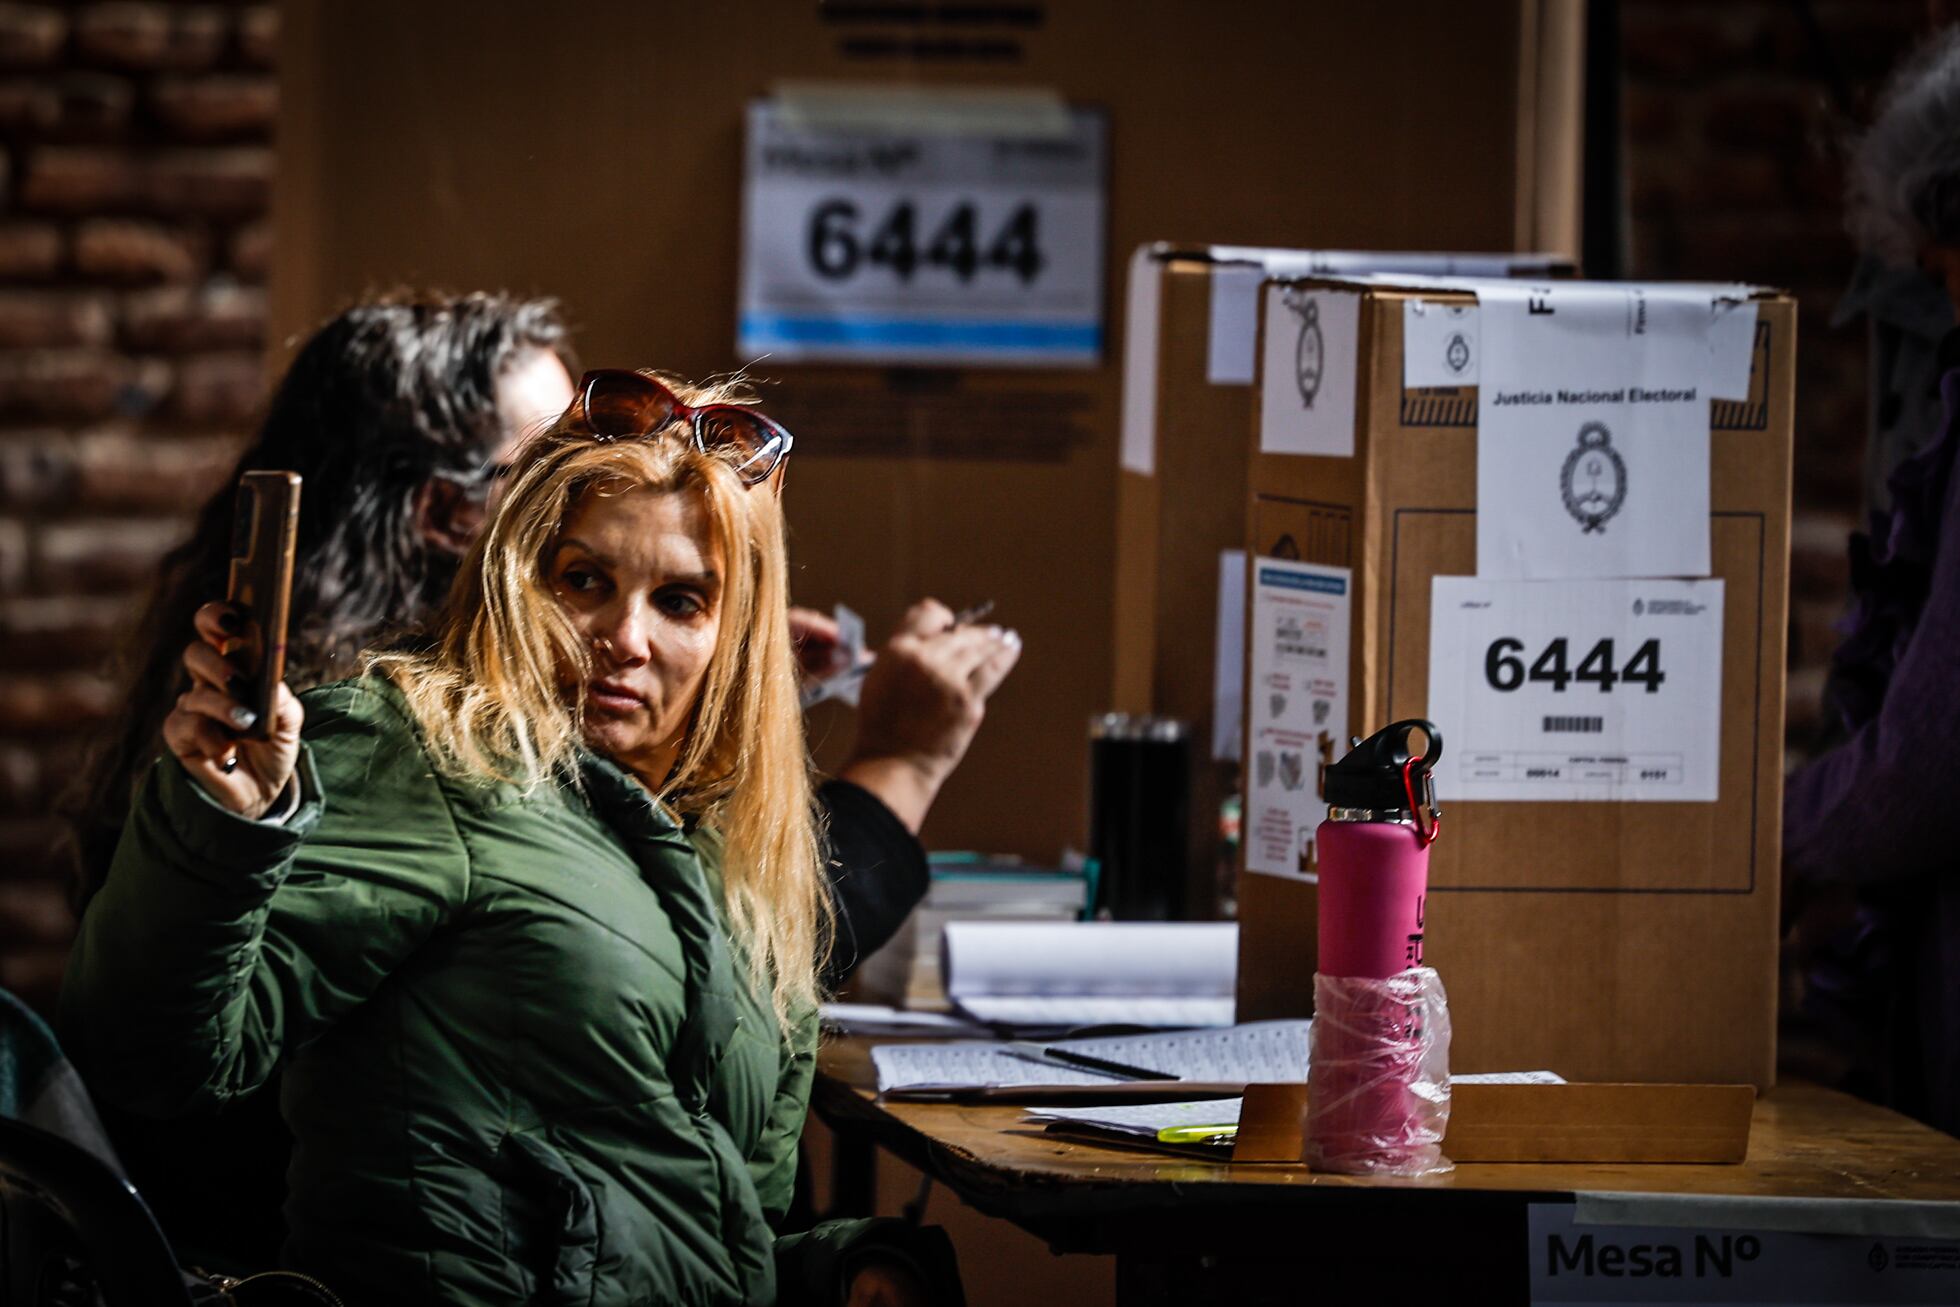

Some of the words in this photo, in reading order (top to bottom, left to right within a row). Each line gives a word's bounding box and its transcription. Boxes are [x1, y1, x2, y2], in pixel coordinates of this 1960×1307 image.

[808, 199, 1044, 283] 6444
[1493, 389, 1553, 406] Justicia
[1557, 387, 1625, 405] Nacional
[1629, 386, 1697, 404] Electoral
[1485, 636, 1666, 694] 6444
[1547, 1233, 1683, 1278] Mesa
